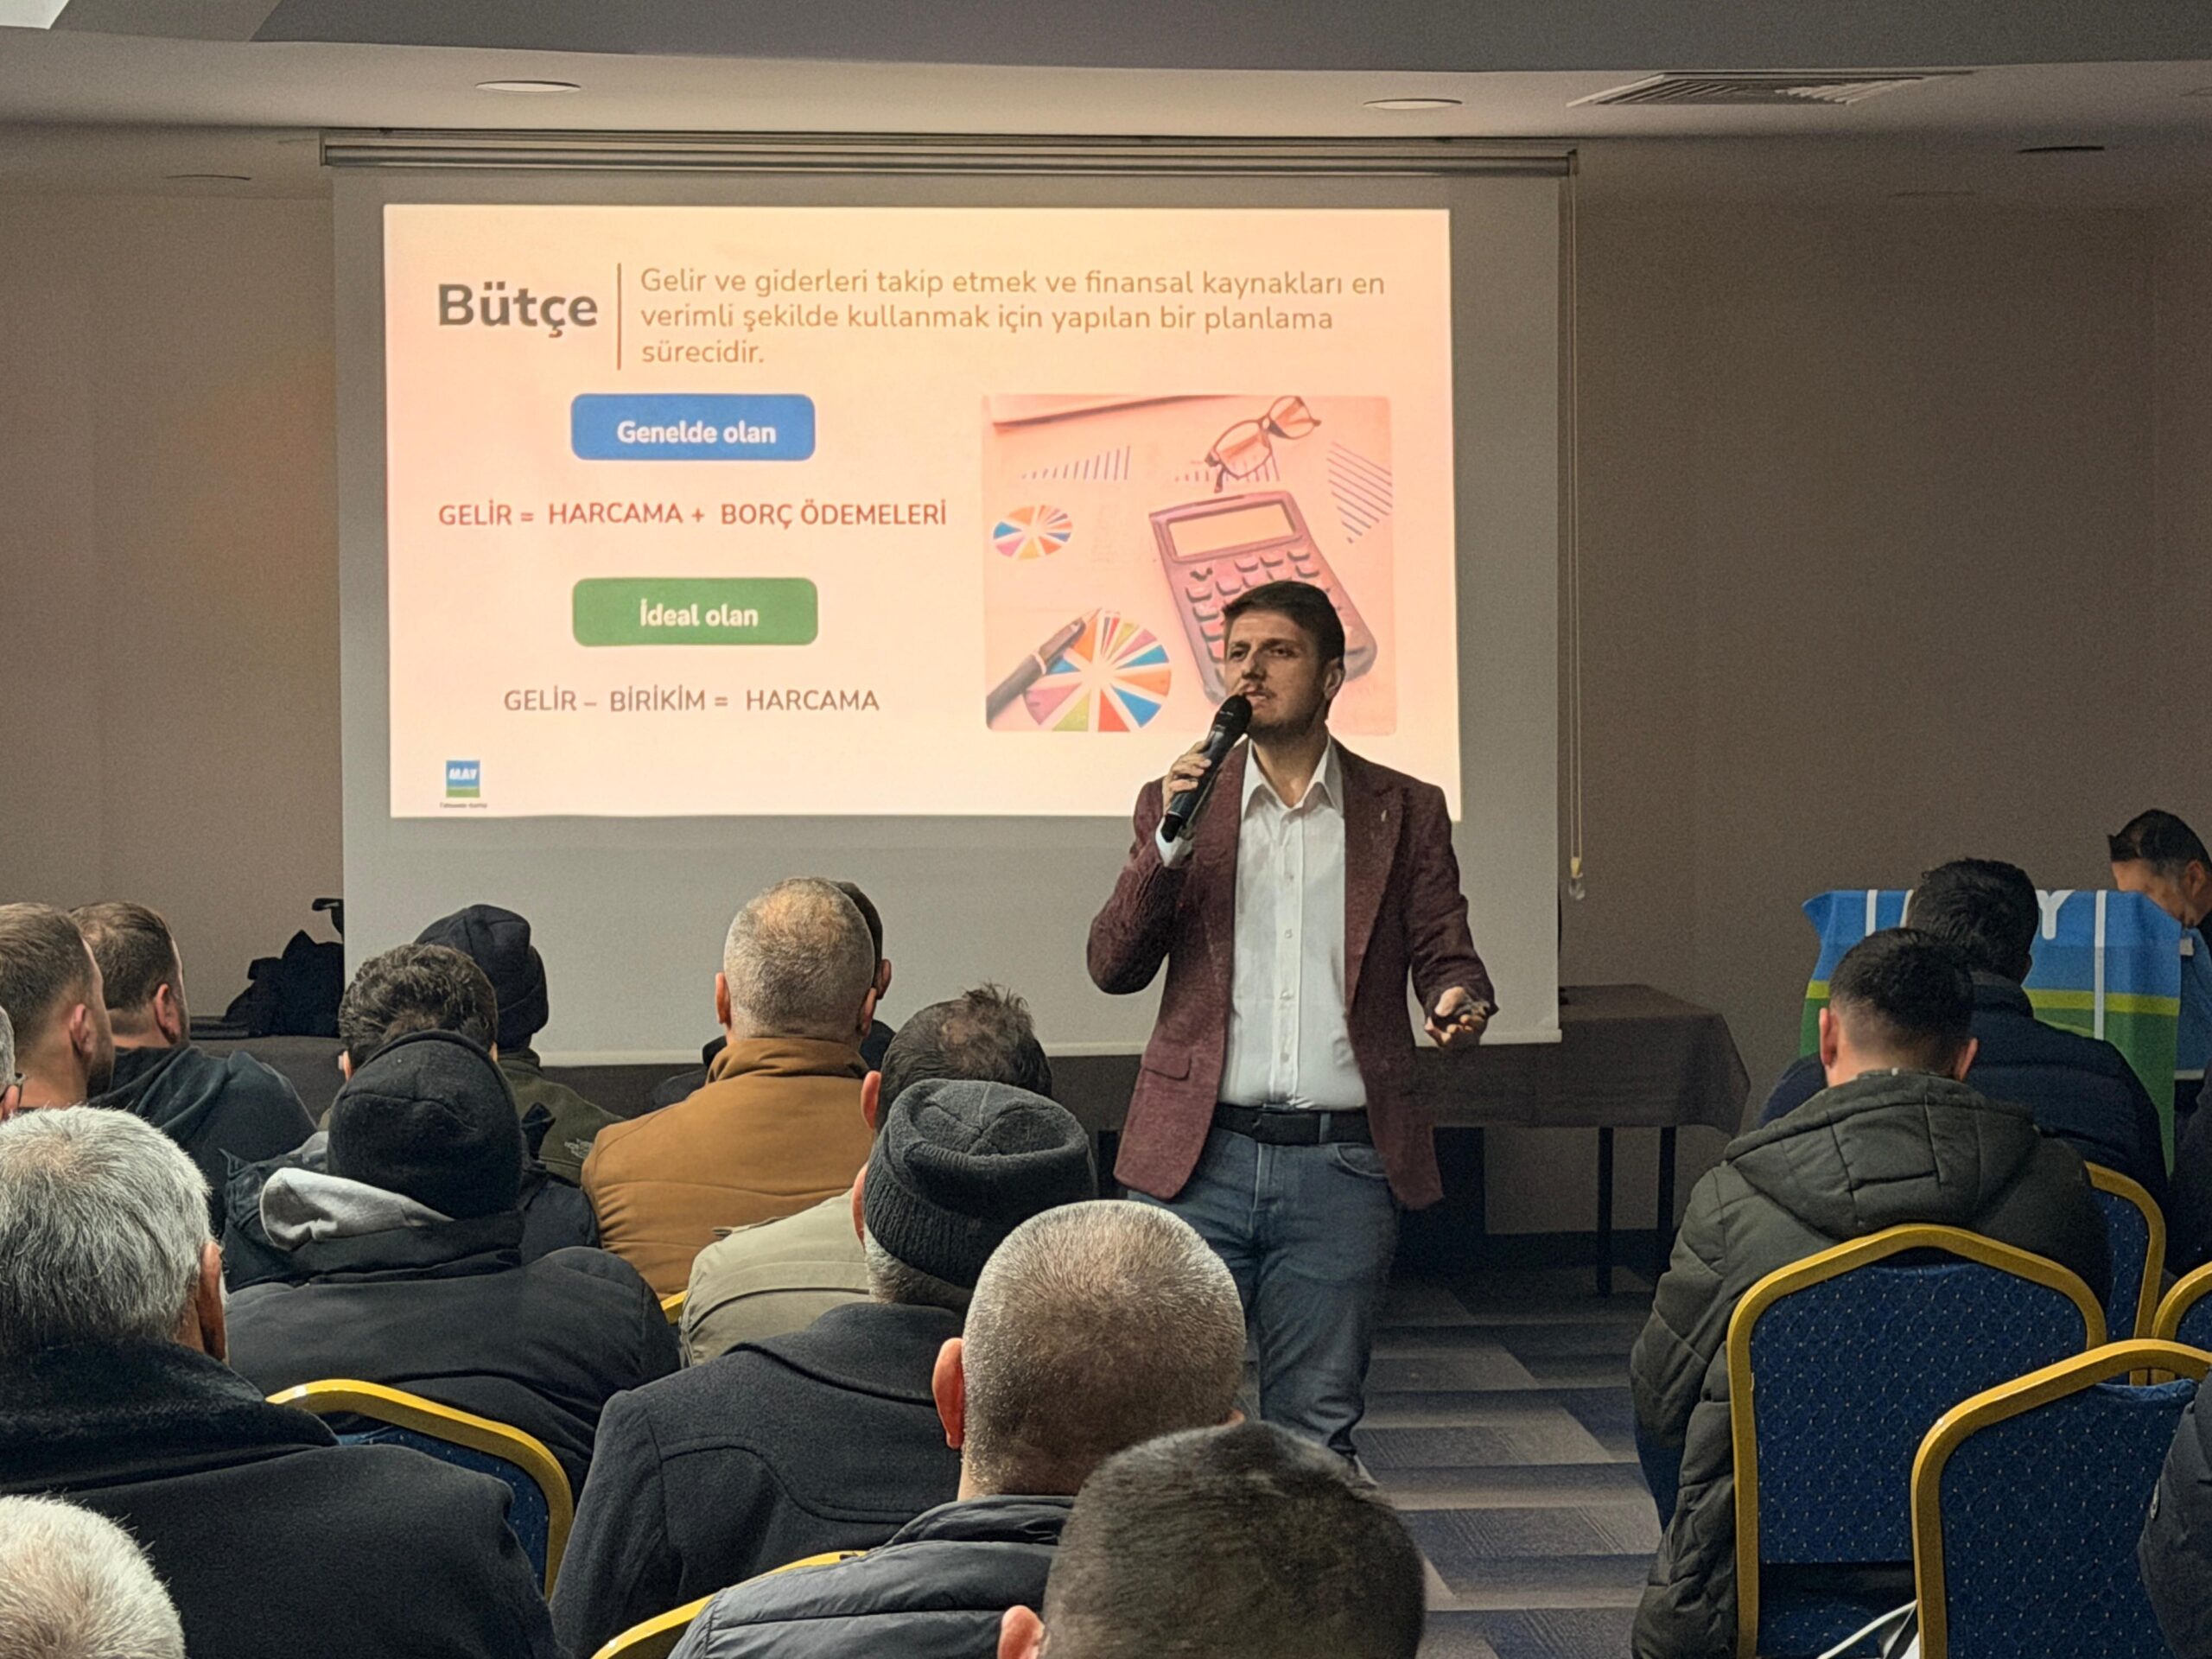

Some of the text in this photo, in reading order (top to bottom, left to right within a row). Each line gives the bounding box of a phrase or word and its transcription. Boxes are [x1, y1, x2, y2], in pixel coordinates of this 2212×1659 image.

[640, 267, 1385, 300] Gelir ve giderleri takip etmek ve finansal kaynakları en
[438, 281, 598, 338] Bütçe
[640, 302, 1333, 335] verimli şekilde kullanmak için yapılan bir planlama
[642, 339, 765, 364] sürecidir.
[616, 419, 777, 444] Genelde olan
[438, 499, 512, 526] GELİR
[549, 501, 684, 525] HARCAMA
[721, 503, 793, 531] BORÇ
[800, 498, 946, 525] ÖDEMELERİ
[639, 598, 759, 627] İdeal olan
[503, 684, 577, 712] GELİR
[610, 683, 706, 713] BİRİKİM
[746, 689, 880, 711] HARCAMA
